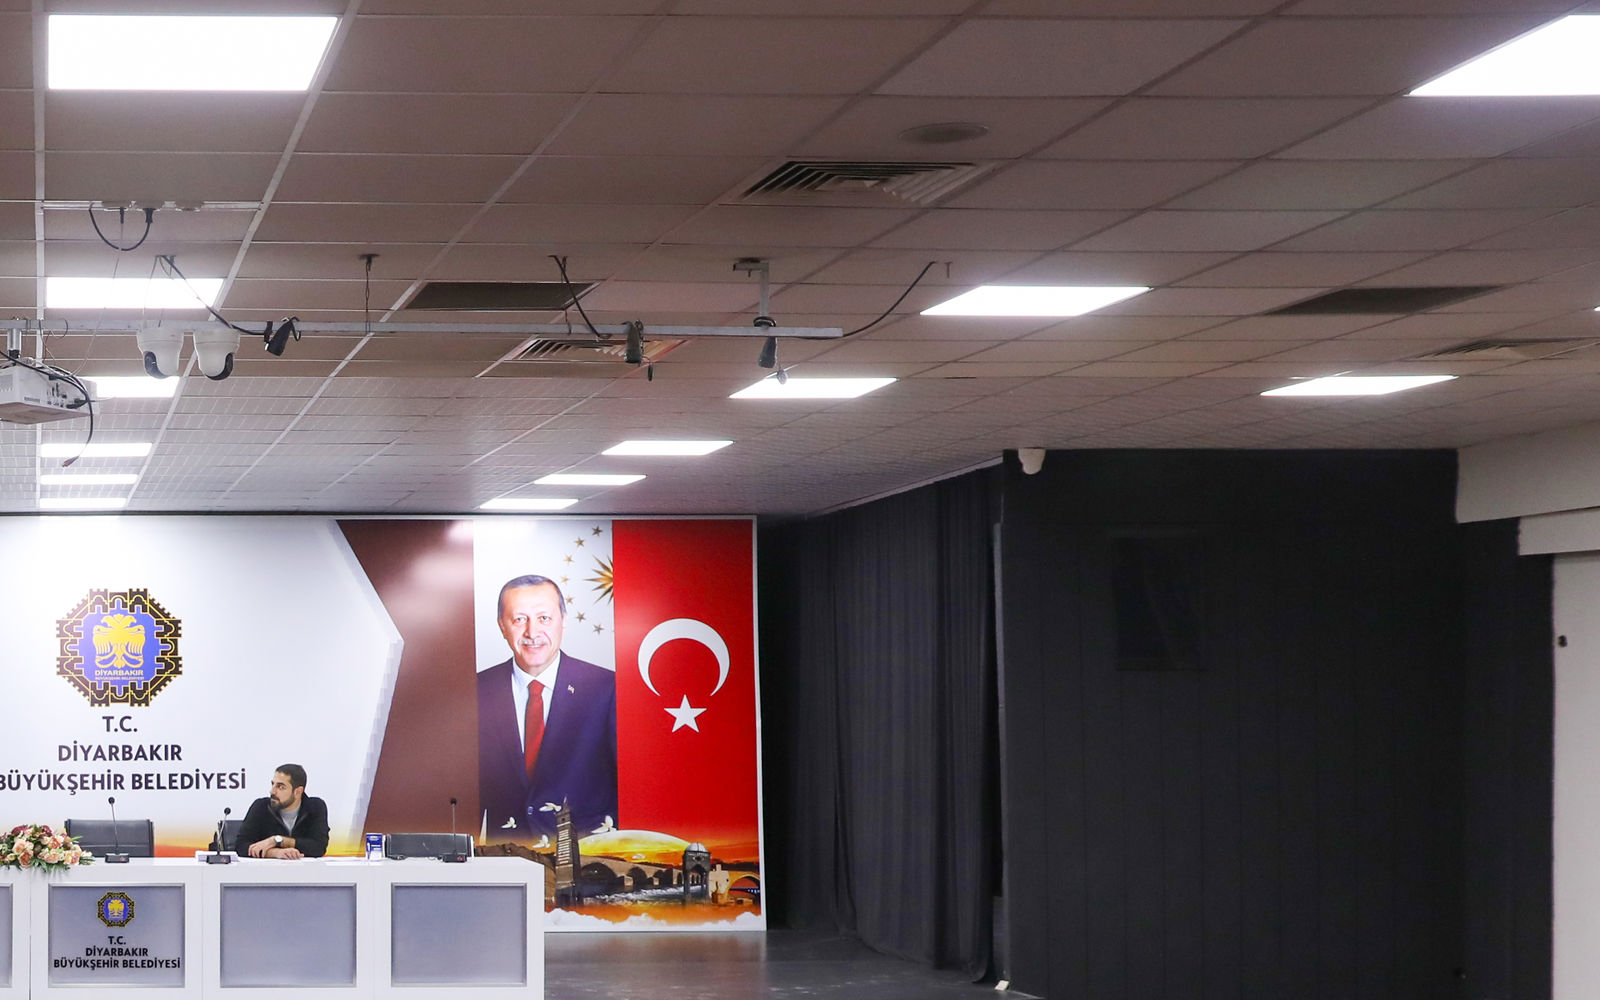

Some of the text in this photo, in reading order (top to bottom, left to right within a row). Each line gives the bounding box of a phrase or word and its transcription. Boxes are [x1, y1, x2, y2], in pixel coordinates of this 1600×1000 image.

[94, 668, 144, 677] DİYARBAKIR
[102, 715, 138, 733] T.C.
[58, 740, 183, 762] DİYARBAKIR
[131, 768, 247, 790] BELEDİYESİ
[107, 935, 126, 945] T.C.
[85, 945, 149, 957] DİYARBAKIR
[53, 957, 180, 970] BÜYÜKŞEHİR BELEDİYESİ
